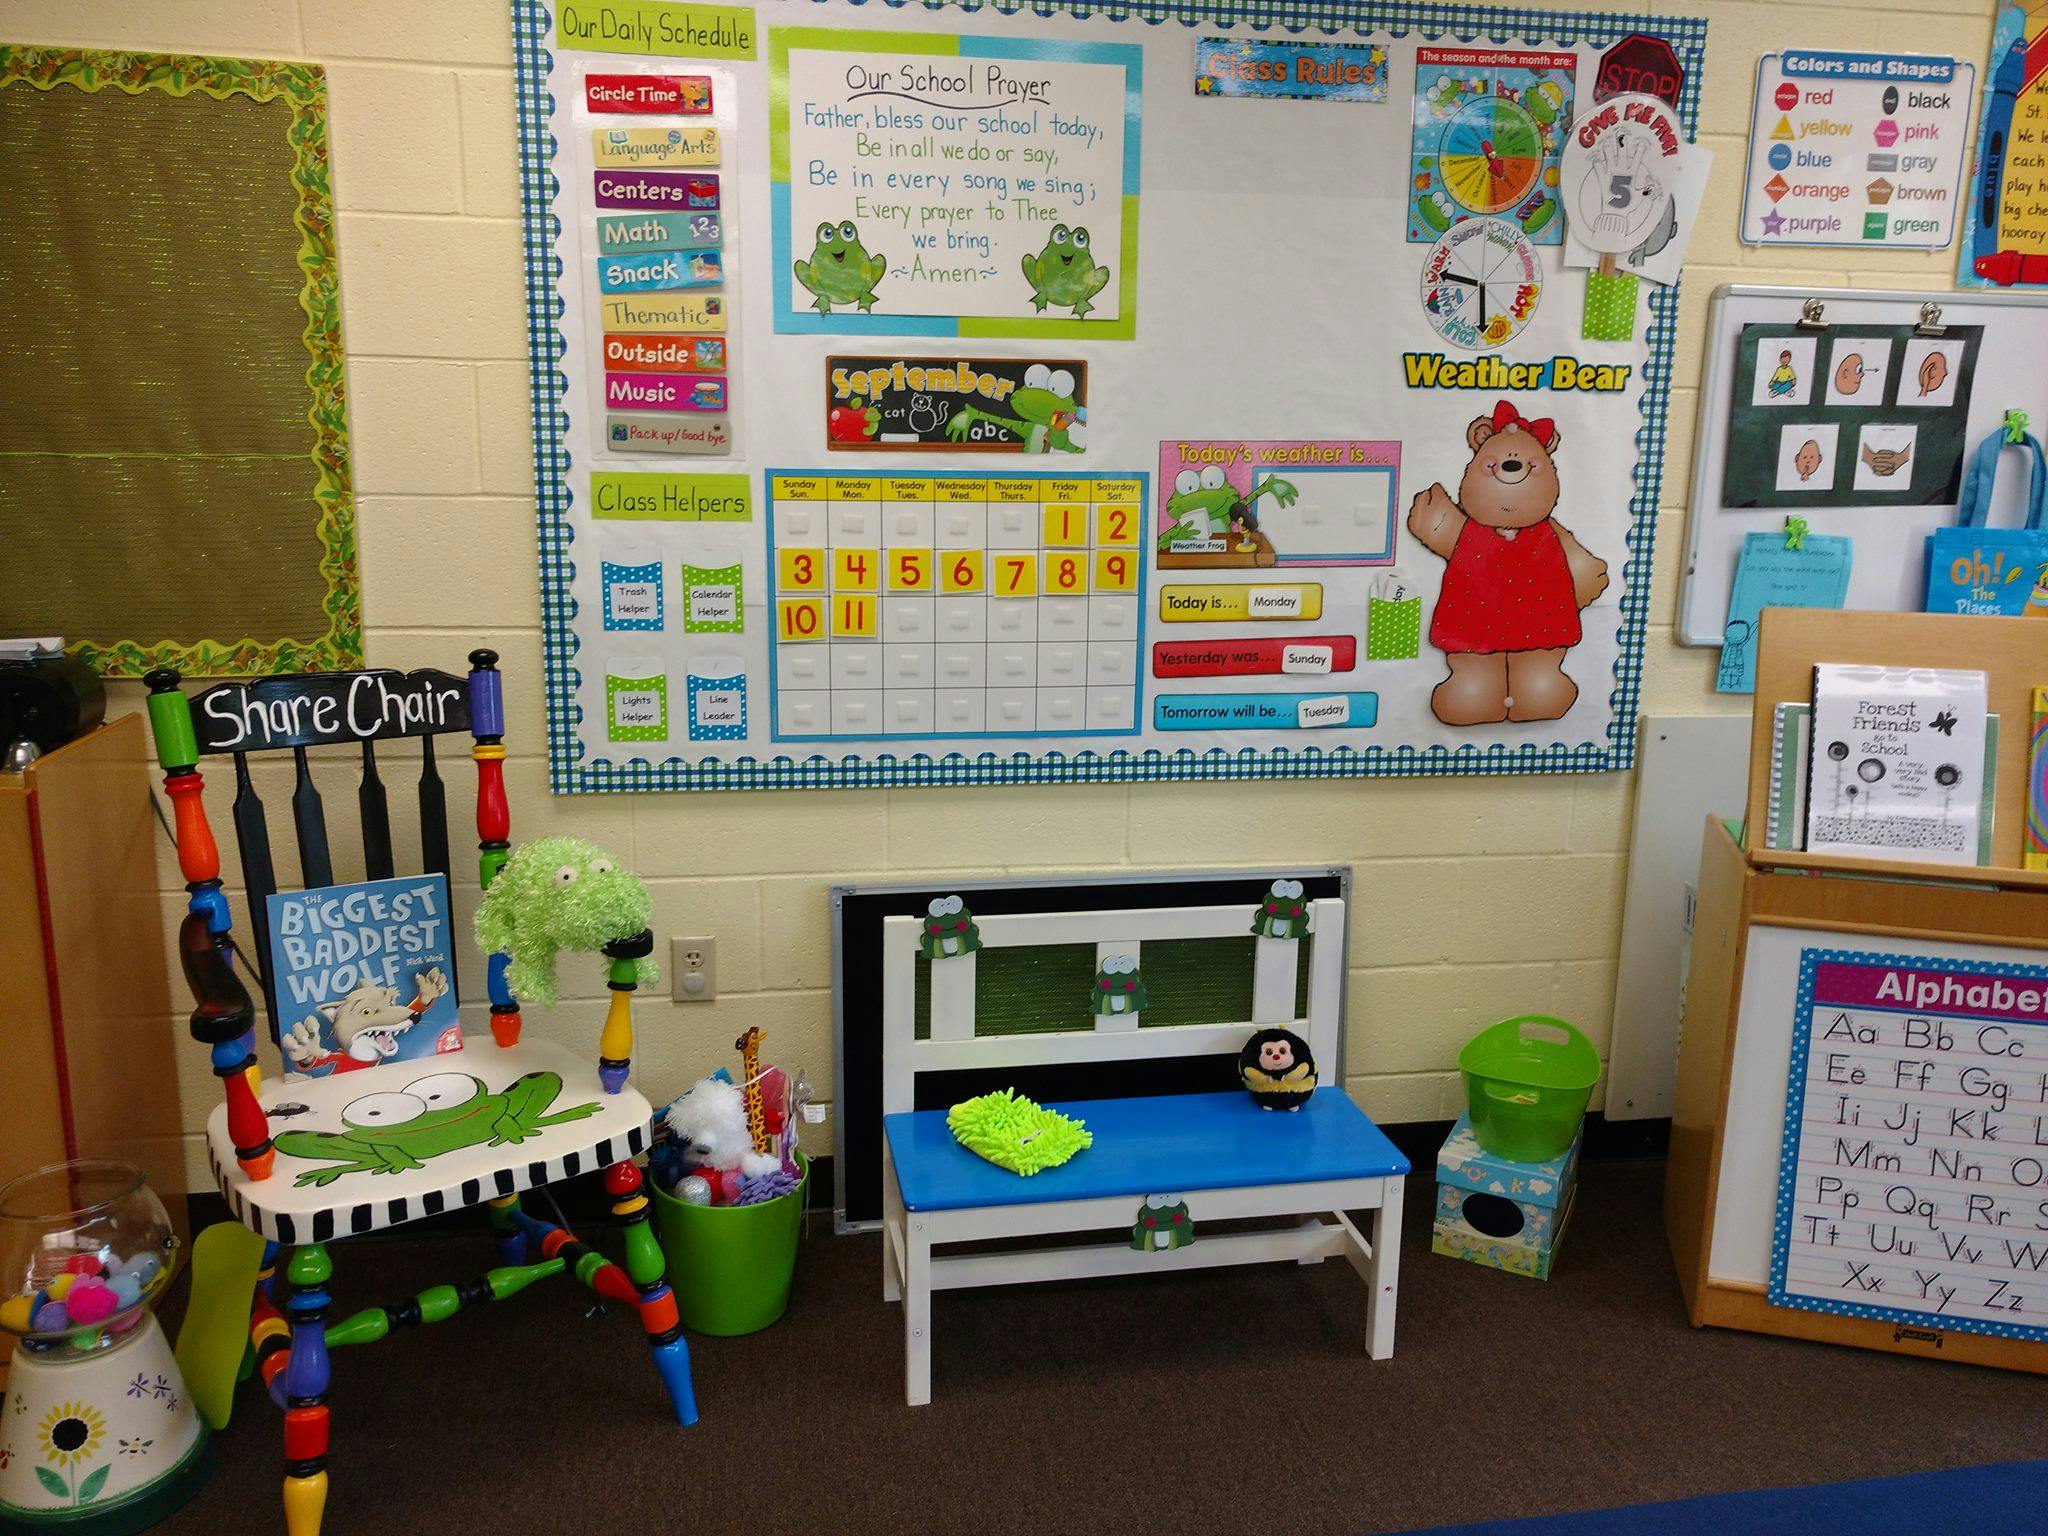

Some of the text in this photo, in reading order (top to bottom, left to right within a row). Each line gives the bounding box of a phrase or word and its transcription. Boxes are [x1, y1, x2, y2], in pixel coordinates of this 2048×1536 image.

[563, 6, 750, 50] Our Daily Schedule
[1422, 51, 1573, 66] The season and the month are:
[1207, 52, 1377, 85] Class Rules
[1787, 57, 1950, 78] Colors and Shapes
[847, 65, 1051, 103] Our School Prayer
[1605, 63, 1675, 96] STOP
[589, 85, 677, 102] Circle Time
[1805, 89, 1833, 104] red
[1908, 92, 1950, 108] black
[804, 103, 869, 128] Father,
[875, 105, 923, 130] bless
[932, 114, 967, 131] our
[979, 109, 1037, 135] school
[1578, 105, 1619, 149] GIVE
[1624, 102, 1656, 126] ME
[1799, 119, 1852, 139] yellow
[1904, 124, 1939, 142] pink
[2018, 129, 2034, 143] We
[601, 139, 716, 161] Language Arts
[857, 133, 1058, 174] Be in all we do or say,
[1797, 151, 1831, 168] blue
[1901, 156, 1937, 173] gray
[2013, 155, 2045, 168] each
[809, 160, 837, 185] Be
[852, 166, 873, 188] in
[887, 172, 949, 197] every
[964, 175, 1007, 200] song
[1016, 178, 1035, 191] we
[2006, 178, 2033, 196] play
[598, 179, 683, 201] Centers
[1608, 175, 1632, 208] 5
[1792, 185, 1849, 202] orange
[1897, 186, 1946, 201] brown
[856, 197, 1058, 229] Every prayer to Thee
[2004, 201, 2021, 220] big
[604, 219, 668, 245] Math
[1490, 221, 1522, 243] CHILLY
[1789, 215, 1841, 234] purple
[1893, 218, 1939, 235] green
[2002, 225, 2047, 244] hooray
[912, 229, 998, 258] we bring.
[606, 260, 679, 286] Snack
[1427, 246, 1450, 284] WARM
[605, 302, 709, 325] Thematic
[608, 342, 689, 363] Outside
[1403, 353, 1631, 392] Weather Bear
[610, 381, 676, 402] Music
[885, 408, 905, 419] cat
[630, 426, 657, 440] Pack
[1178, 443, 1252, 467] Today's
[1258, 444, 1343, 463] weather
[783, 479, 816, 491] Sunday
[836, 480, 871, 491] Monday
[890, 481, 925, 492] Tuesday
[936, 481, 985, 492] Wednesday
[994, 482, 1033, 493] Thursday
[1052, 482, 1078, 493] Friday
[1097, 483, 1135, 493] Saturday
[597, 484, 745, 521] Class Helpers
[790, 490, 810, 499] Sun.
[842, 490, 864, 499] Mon.
[897, 490, 919, 499] Tues.
[950, 491, 972, 500] Wed.
[1000, 491, 1026, 500] Thurs.
[1058, 491, 1072, 500] Fri.
[1107, 492, 1125, 500] Sat.
[1109, 510, 1127, 540] 2
[1172, 541, 1225, 552] Weather Frog
[793, 554, 812, 584] 3
[847, 554, 866, 584] 4
[901, 556, 920, 586] 5
[953, 557, 973, 586] 6
[1007, 561, 1025, 590] 7
[1058, 559, 1076, 588] 8
[1107, 556, 1126, 585] 9
[1951, 549, 2004, 587] Oh!
[619, 587, 647, 597] Trash
[692, 590, 733, 599] Calendar
[1971, 586, 1996, 600] The
[618, 605, 650, 615] Helper
[698, 607, 729, 617] Helper
[1167, 596, 1208, 611] Today
[1254, 596, 1296, 608] Monday
[1955, 599, 2001, 615] Places
[786, 604, 816, 635] 10
[845, 600, 863, 630] 11
[1160, 652, 1228, 667] Yesterday
[1288, 653, 1327, 666] Sunday
[622, 696, 652, 706] Lights
[709, 695, 729, 704] Line
[203, 676, 460, 747] Share Chair
[703, 711, 736, 721] Leader
[1161, 705, 1232, 718] Tomorrow
[1234, 705, 1255, 718] will
[1303, 705, 1345, 718] Tuesday
[1857, 701, 1916, 717] Forest
[622, 713, 654, 723] Helper
[1852, 717, 1921, 732] Friends
[1861, 742, 1908, 756] School
[302, 895, 322, 905] THE
[280, 884, 437, 936] BIGGEST
[282, 919, 441, 972] BADDEST
[286, 955, 400, 1004] WOLF
